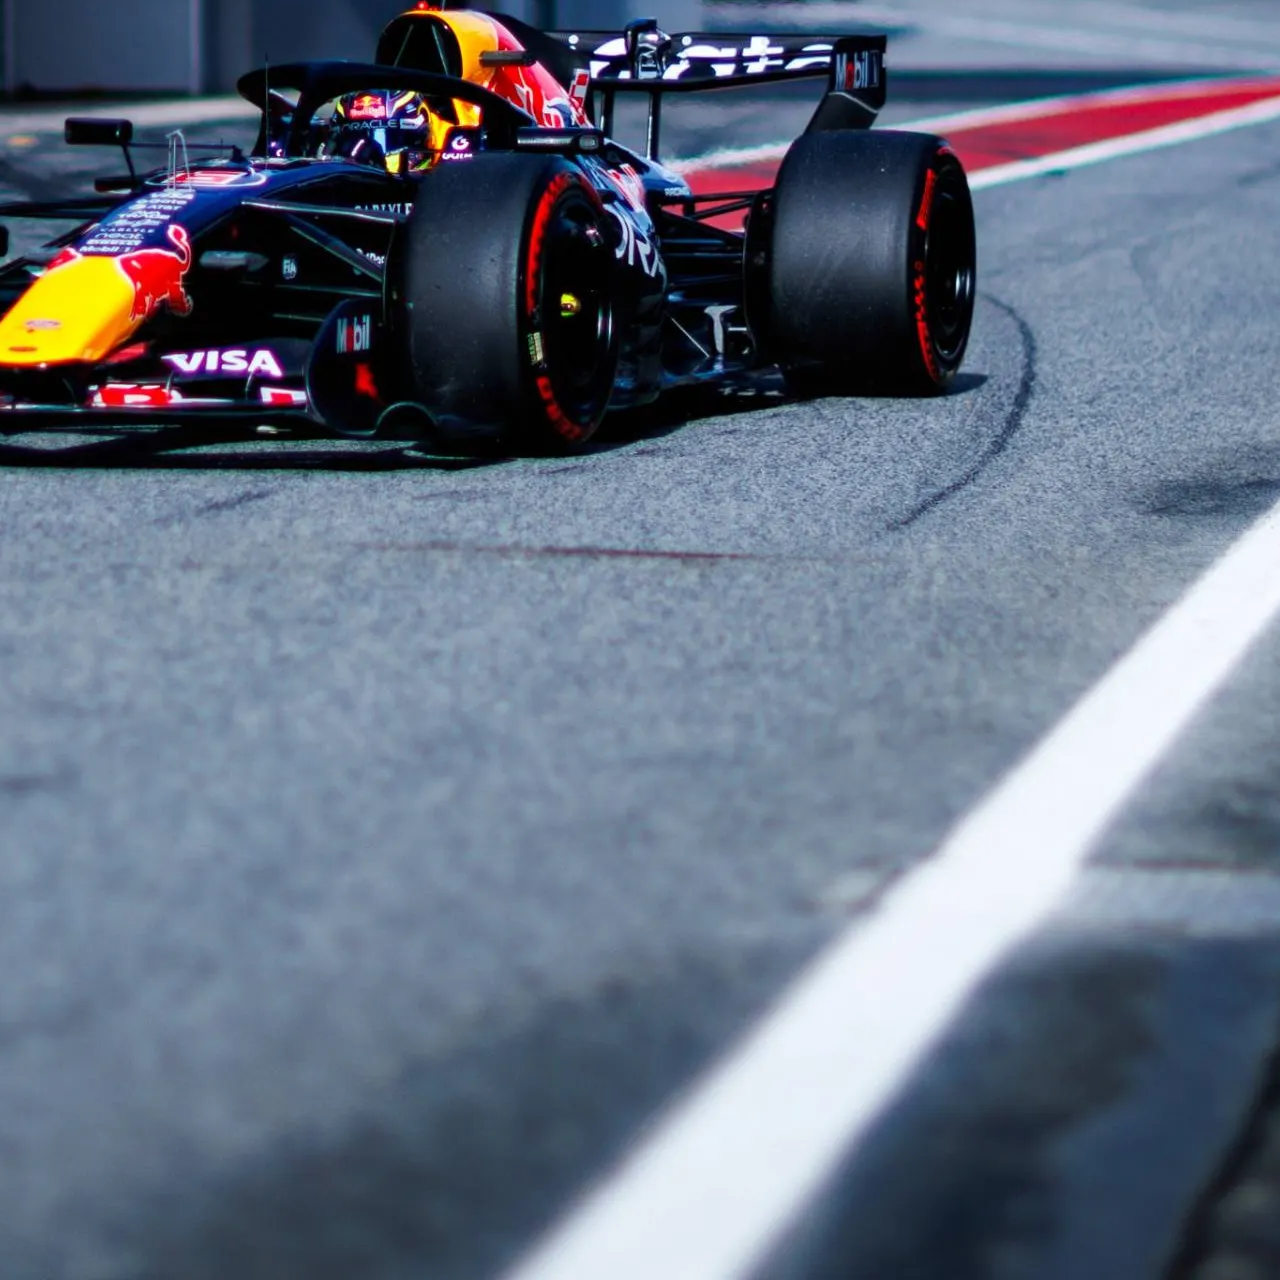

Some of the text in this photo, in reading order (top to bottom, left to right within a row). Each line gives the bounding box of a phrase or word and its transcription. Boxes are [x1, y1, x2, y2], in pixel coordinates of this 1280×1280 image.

[834, 49, 868, 88] Mobil
[336, 314, 370, 354] Mobil
[161, 350, 282, 377] VISA
